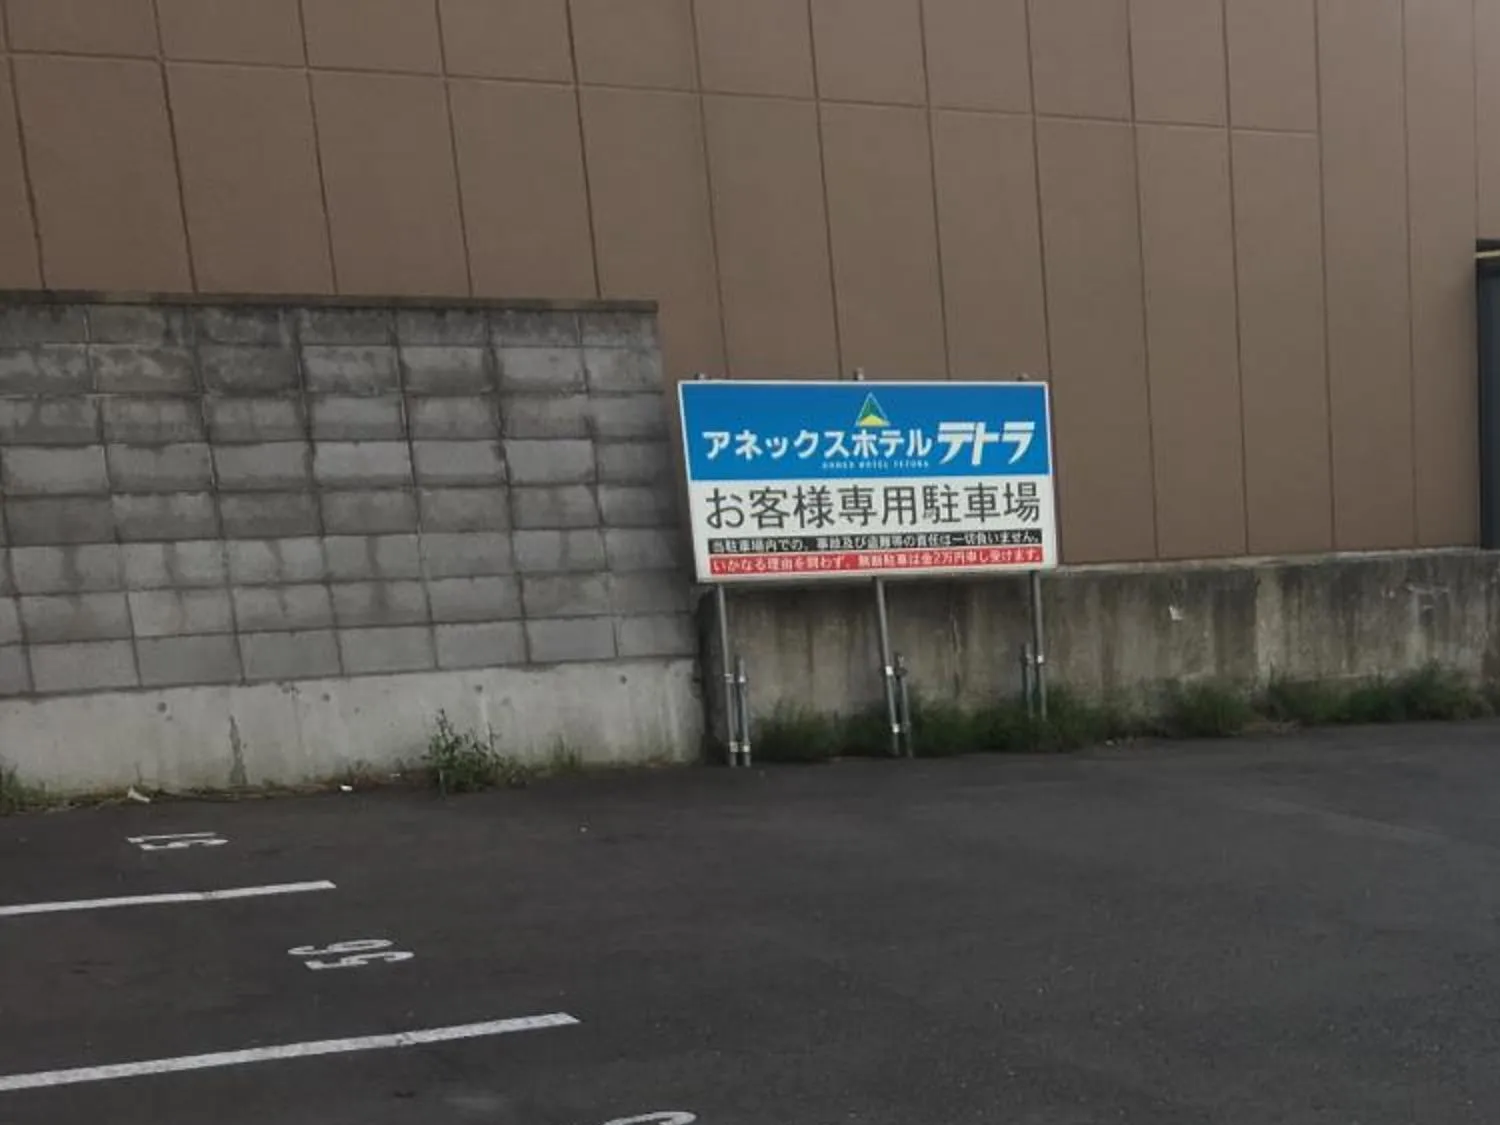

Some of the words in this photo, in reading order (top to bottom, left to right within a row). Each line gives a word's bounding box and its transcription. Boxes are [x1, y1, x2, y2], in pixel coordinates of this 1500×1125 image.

[704, 481, 1041, 530] お客様専用駐車場
[288, 939, 415, 970] 56
